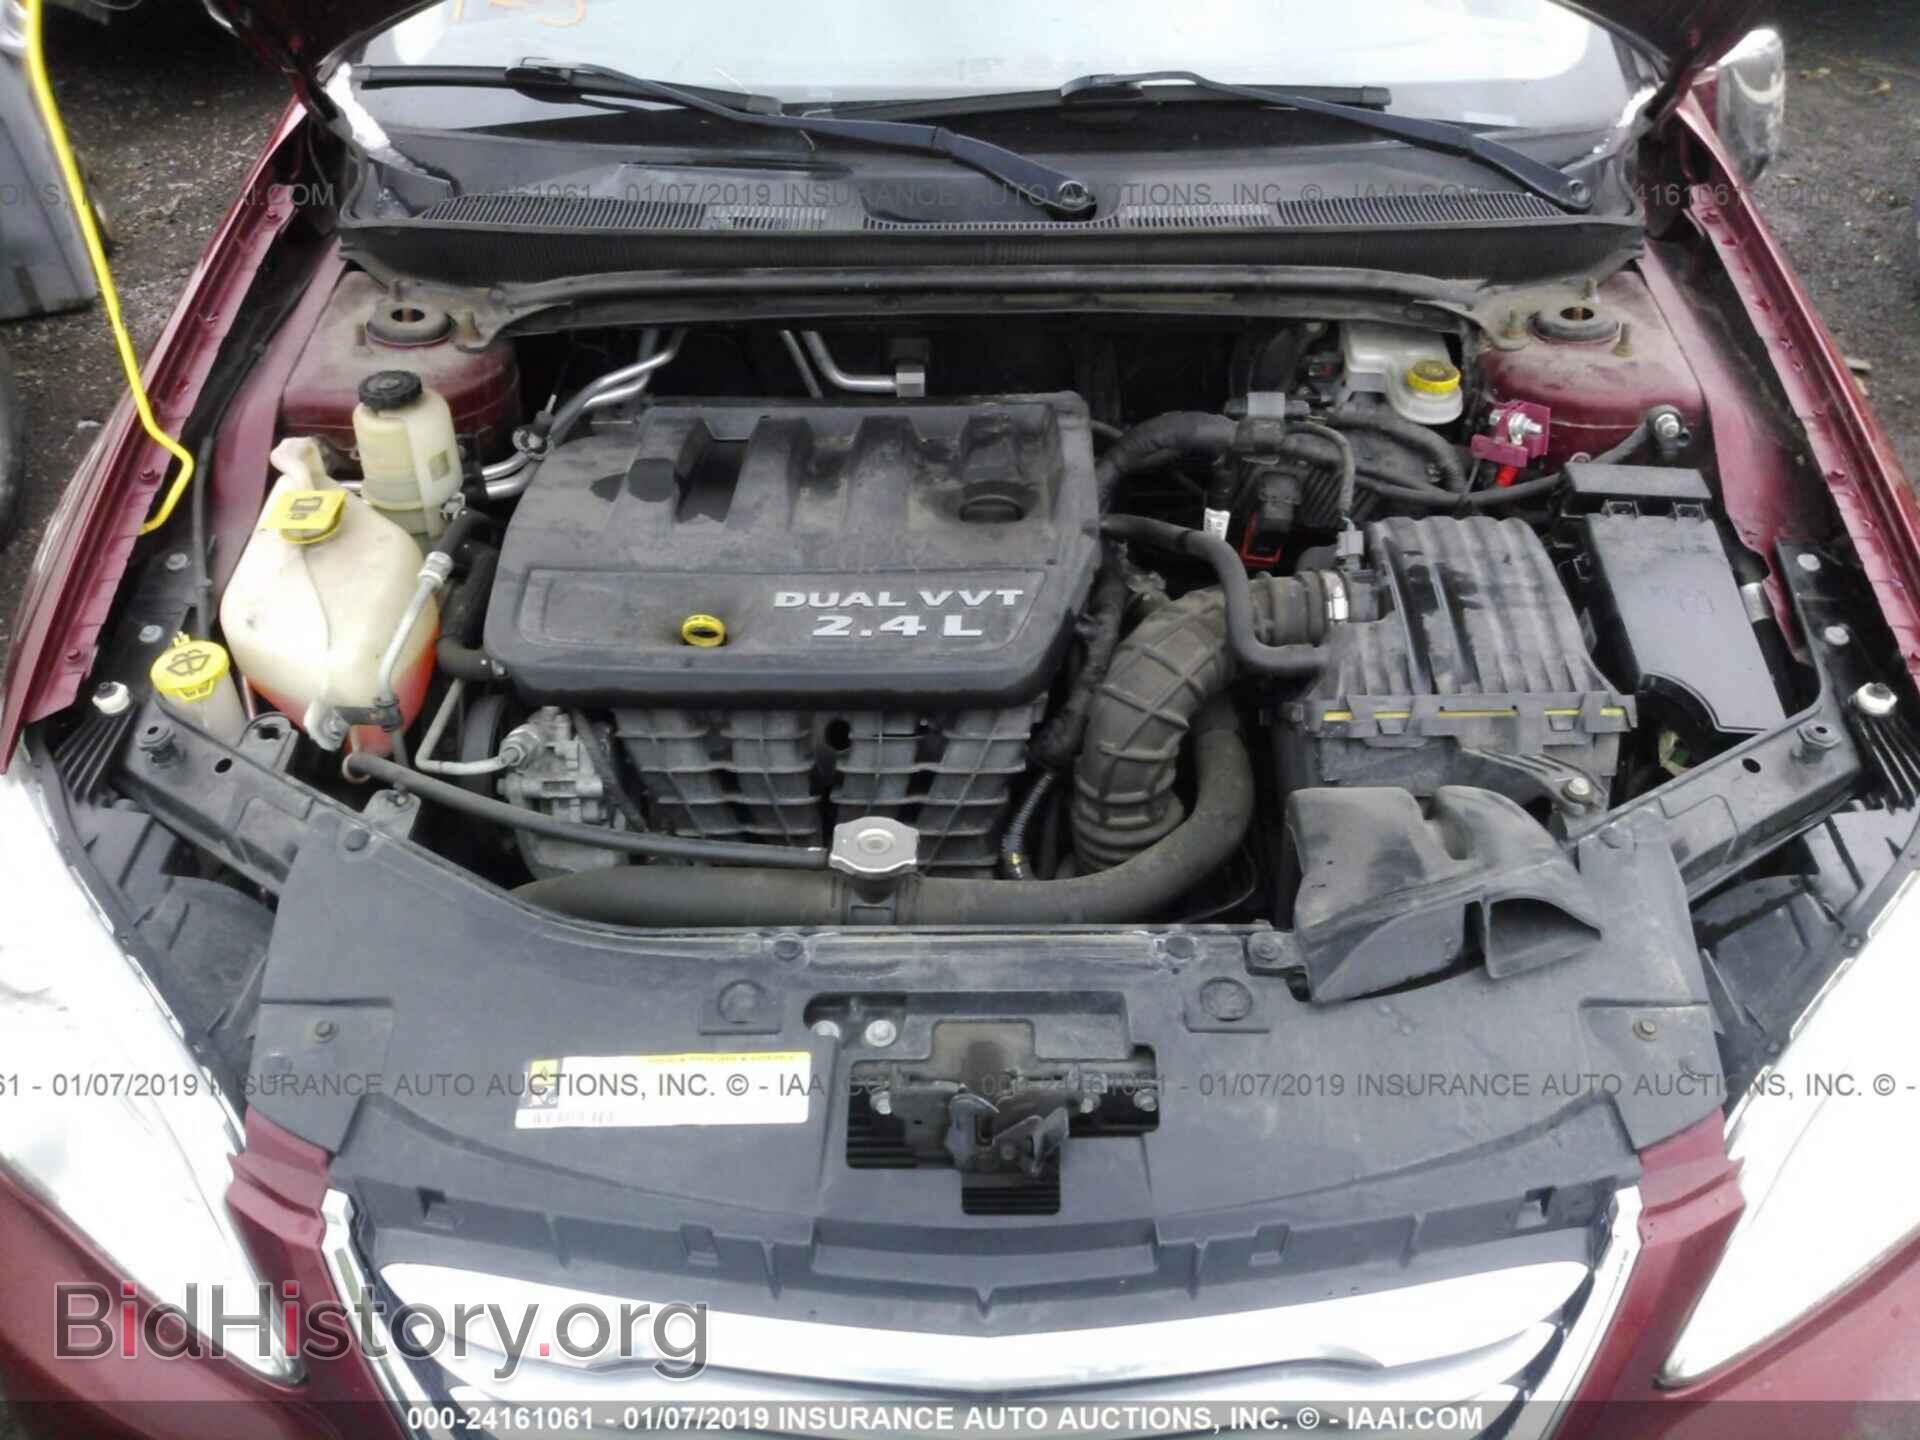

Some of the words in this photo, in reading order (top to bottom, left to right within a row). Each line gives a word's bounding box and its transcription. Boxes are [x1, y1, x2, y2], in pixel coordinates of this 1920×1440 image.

[773, 591, 906, 607] DUAL
[919, 590, 1025, 606] VVT
[812, 615, 927, 636] 2.4
[943, 615, 983, 636] L
